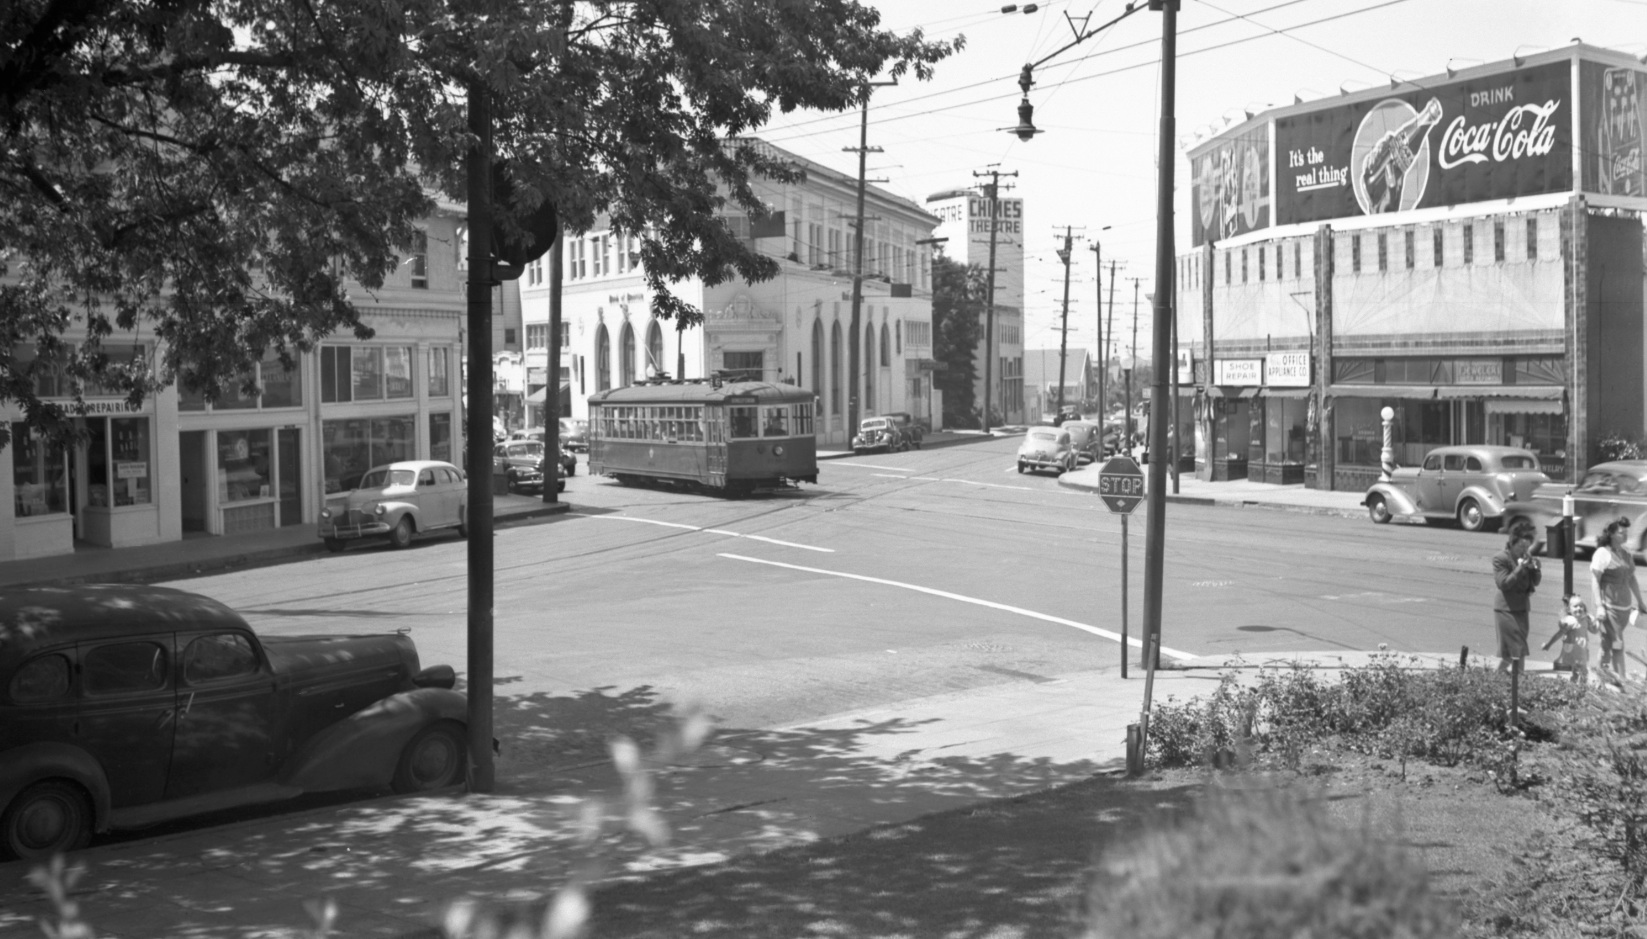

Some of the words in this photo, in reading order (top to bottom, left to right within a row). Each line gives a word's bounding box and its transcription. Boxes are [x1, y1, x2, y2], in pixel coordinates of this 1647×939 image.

[1470, 86, 1514, 107] DRINK
[1439, 98, 1561, 170] Coca-Cola
[1289, 148, 1304, 168] It's
[1306, 146, 1324, 165] the
[1296, 167, 1317, 187] real
[1318, 165, 1348, 186] thing
[969, 220, 1021, 233] THETRE
[1229, 362, 1255, 370] SHOE
[1282, 355, 1307, 366] OFFICE
[1226, 372, 1257, 380] REPAIR
[1268, 366, 1297, 377] APPLIANCE
[1101, 477, 1143, 495] STOP
